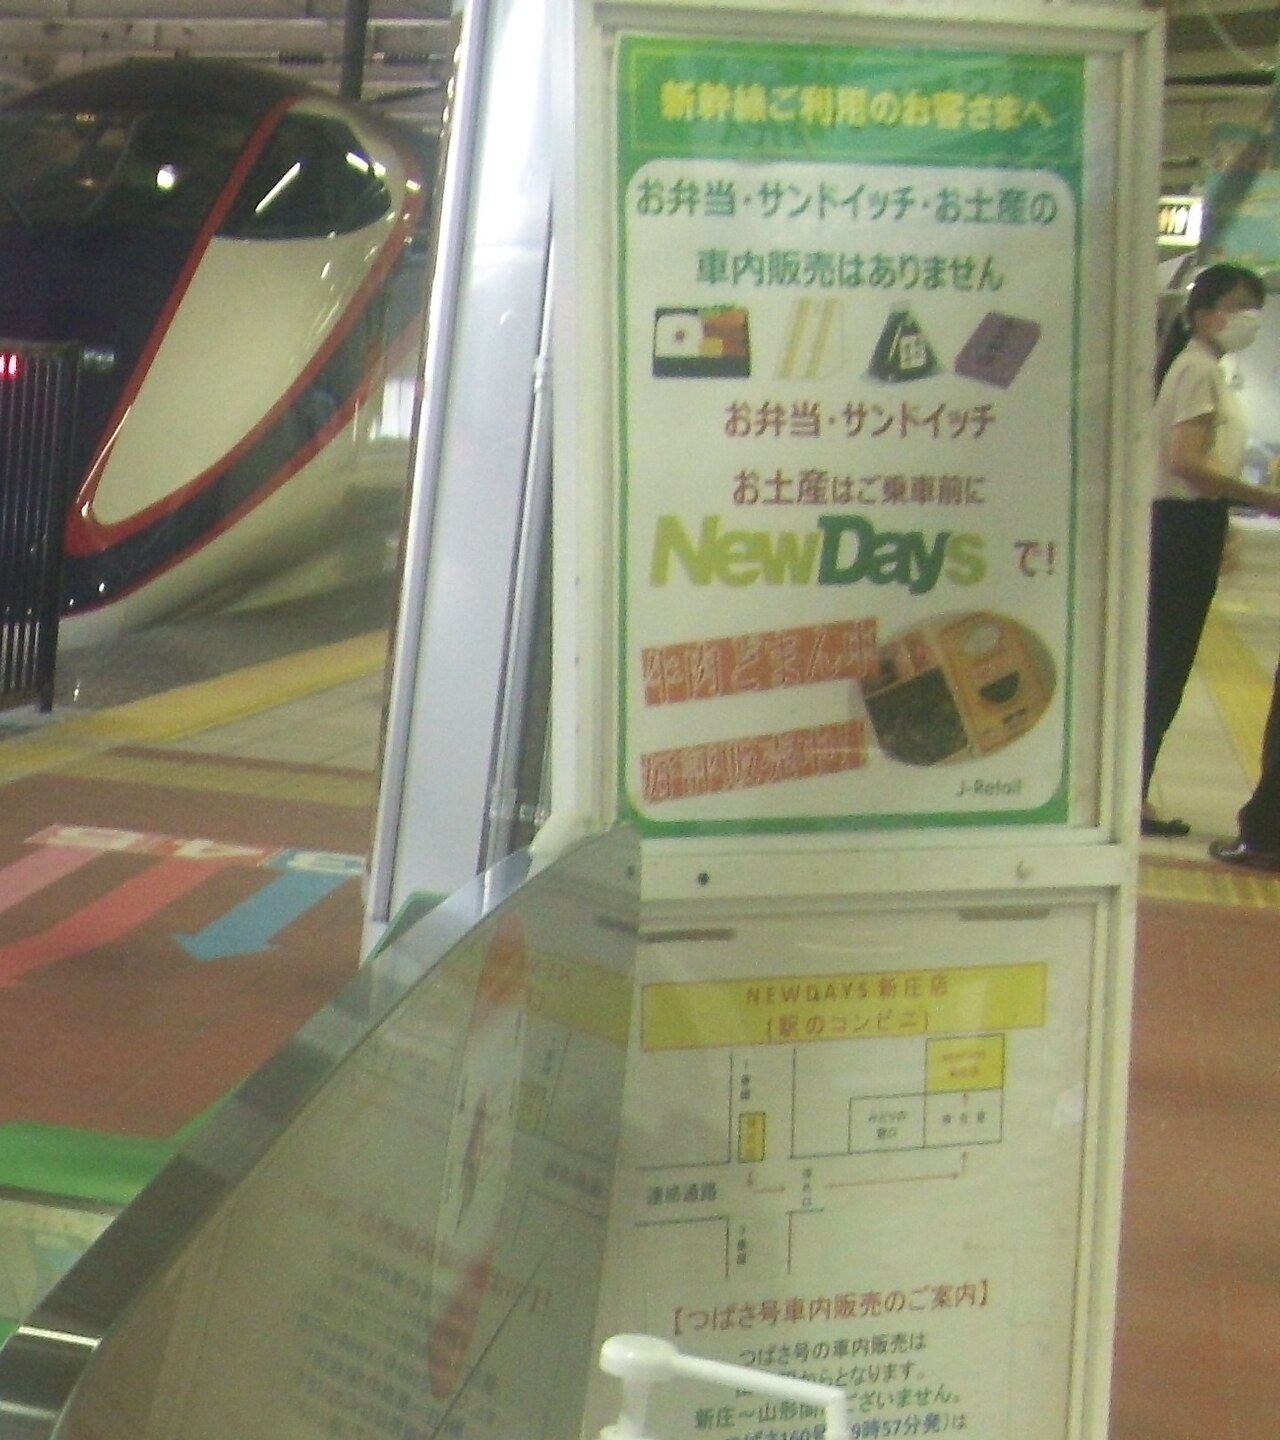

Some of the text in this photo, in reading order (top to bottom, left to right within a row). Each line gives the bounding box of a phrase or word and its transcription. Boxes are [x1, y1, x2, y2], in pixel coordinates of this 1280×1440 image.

[661, 80, 1054, 131] 新幹線ご利用のお客さまへ
[636, 178, 1058, 225] お弁当・サンドイッチ・お土産の
[697, 248, 1004, 292] 車内販売はありません
[724, 401, 996, 439] お弁当・サンドイッチ
[733, 468, 987, 506] お土産はご乗車前に
[649, 513, 988, 594] NewDays
[740, 1331, 926, 1367] つばさ号の車内販売は
